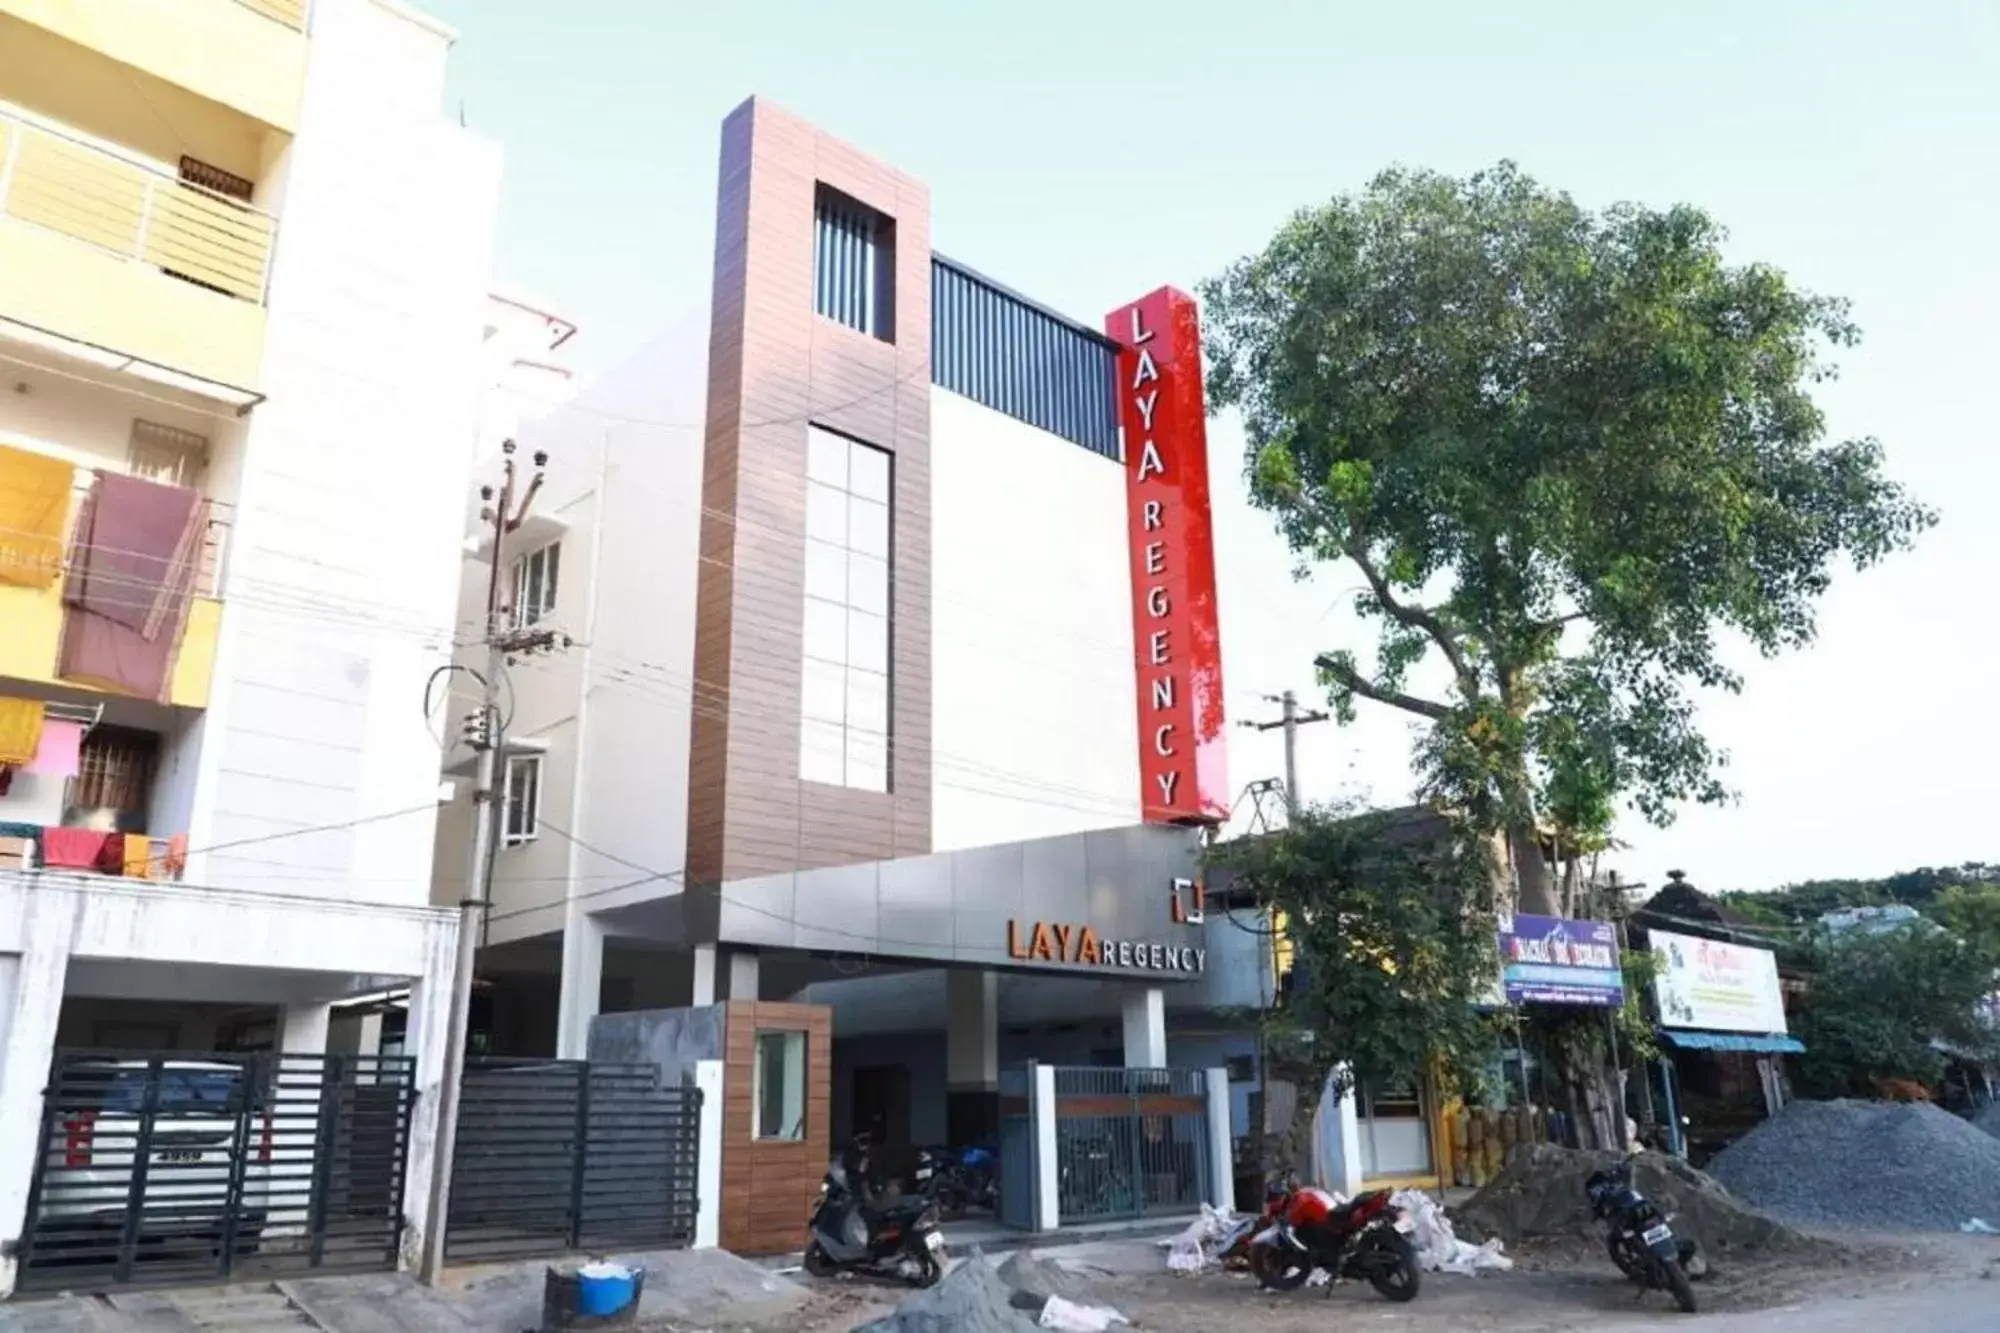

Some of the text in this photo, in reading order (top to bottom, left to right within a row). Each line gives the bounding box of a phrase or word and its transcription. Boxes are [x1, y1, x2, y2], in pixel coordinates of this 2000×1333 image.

[1132, 308, 1177, 806] LAYA REGENCY
[1008, 919, 1206, 972] LAYA REGENCY
